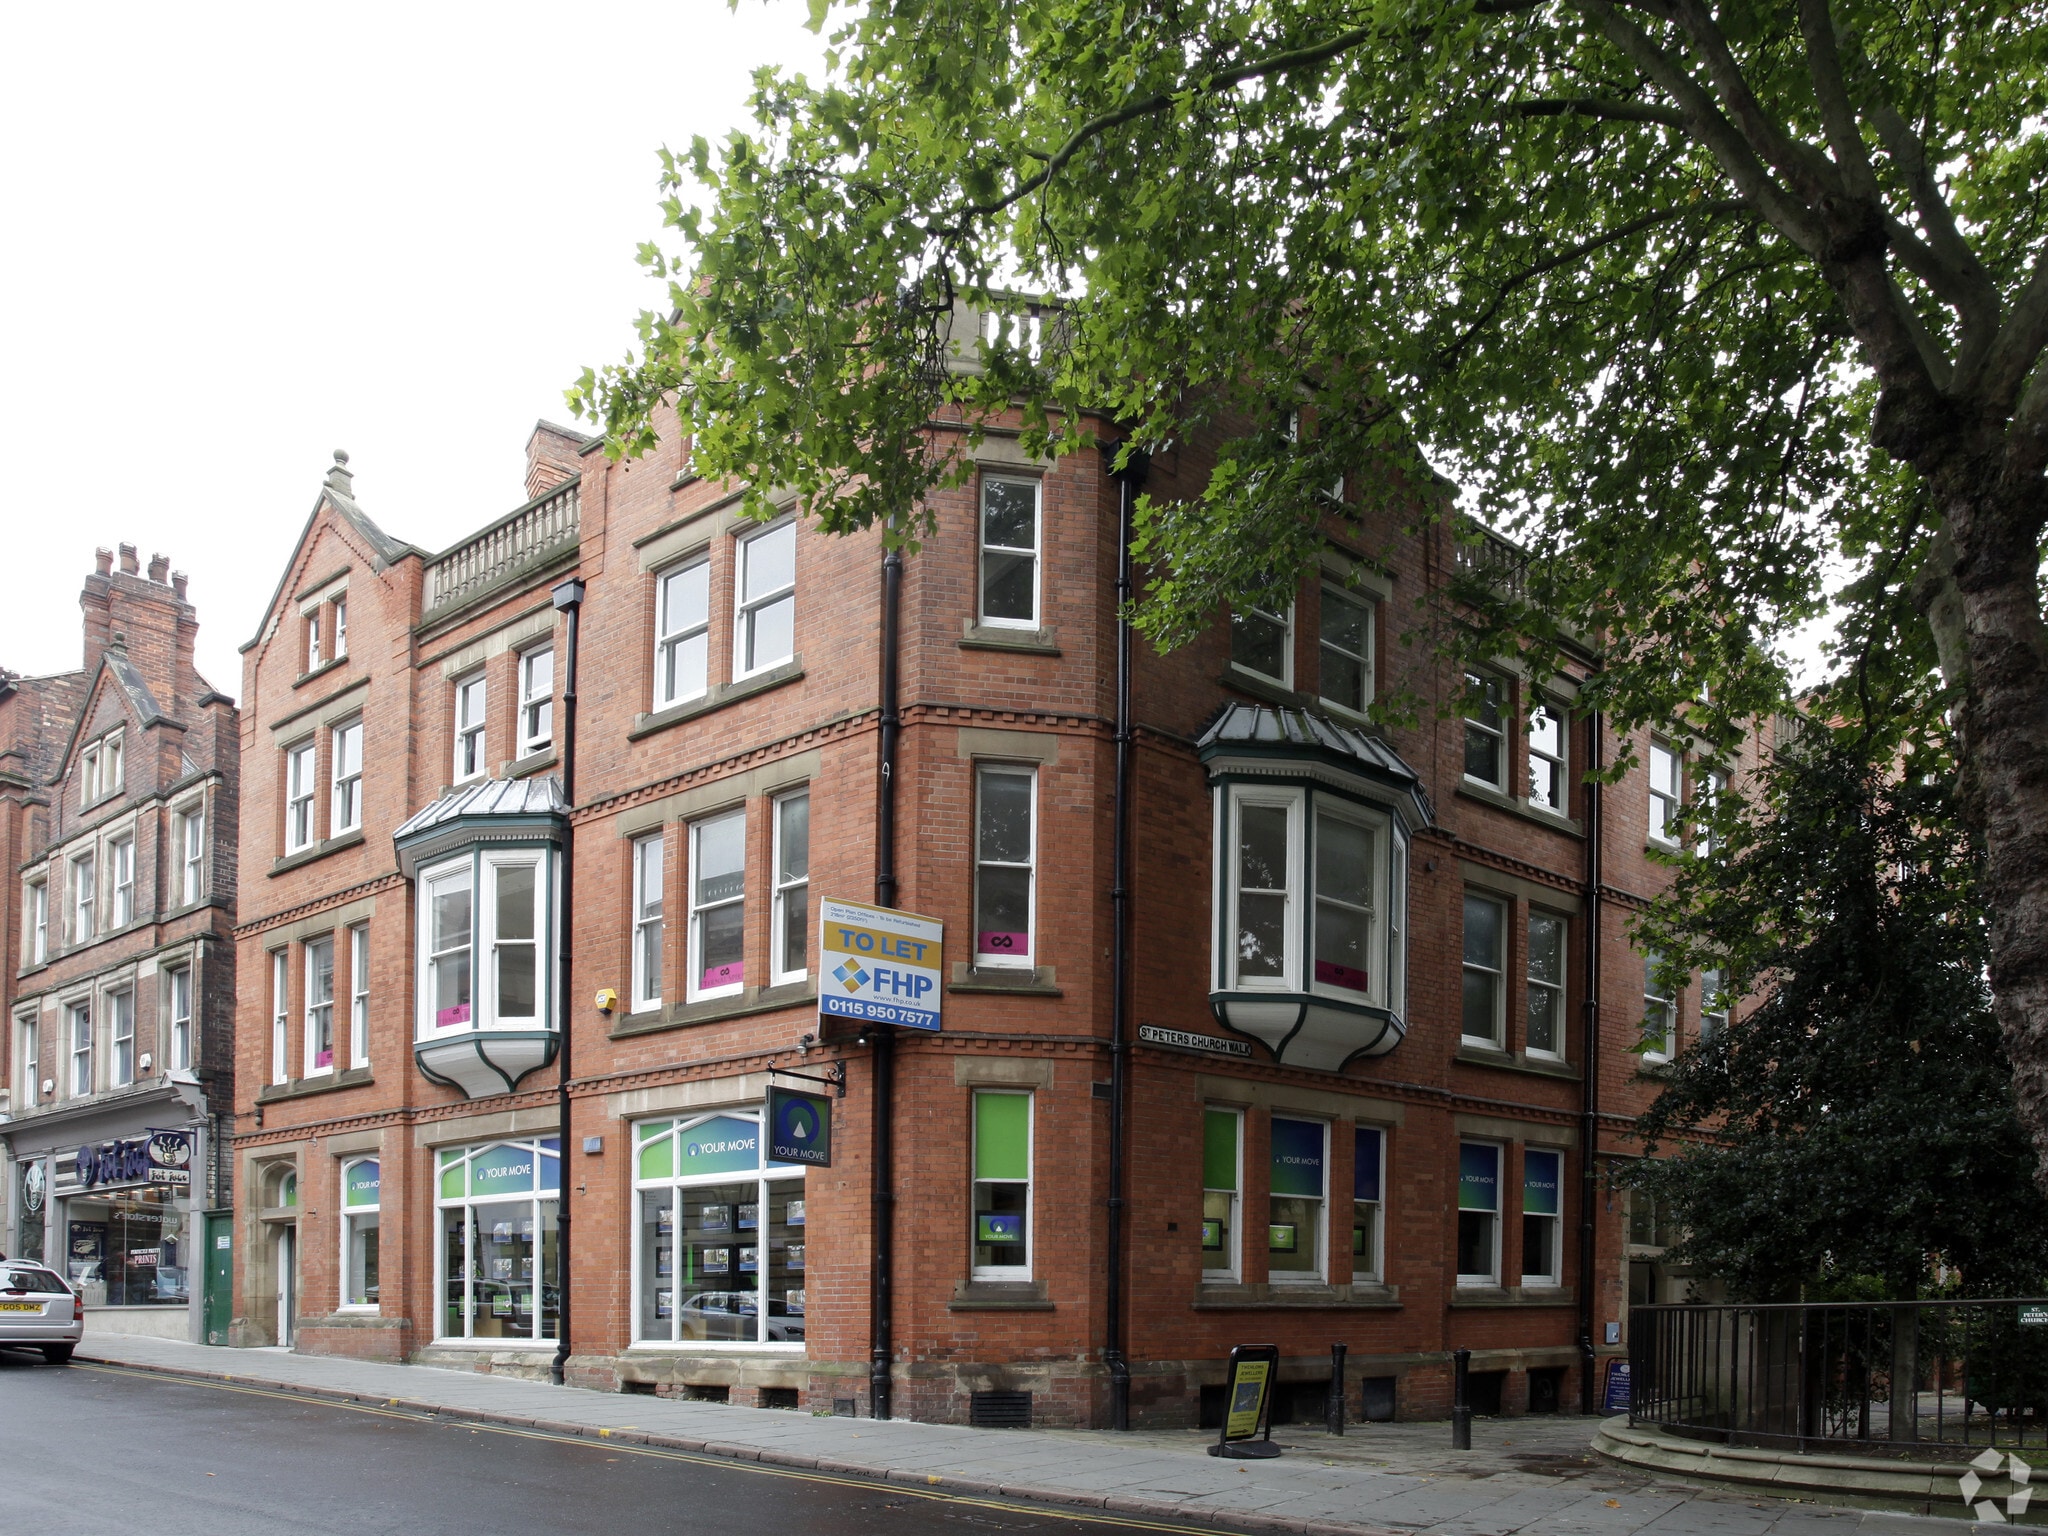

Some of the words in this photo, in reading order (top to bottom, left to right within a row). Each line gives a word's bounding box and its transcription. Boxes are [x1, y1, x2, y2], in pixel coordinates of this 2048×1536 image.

[838, 929, 875, 951] TO
[881, 937, 928, 960] LET
[873, 967, 933, 999] FHP
[873, 994, 921, 1007] www.fhp.co.uk
[828, 999, 863, 1014] 0115
[866, 1005, 896, 1020] 950
[898, 1010, 933, 1026] 7577
[1152, 1030, 1189, 1044] PETERS
[1191, 1036, 1227, 1051] CHURCH
[1228, 1042, 1251, 1053] WALK
[700, 1142, 726, 1154] YOUR
[727, 1138, 755, 1150] MOVE
[774, 1145, 798, 1157] YOUR
[800, 1149, 824, 1160] MOVE
[1282, 1156, 1300, 1165] YOUR
[1301, 1157, 1319, 1166] MOVE
[486, 1167, 507, 1178] YOUR
[508, 1164, 531, 1175] MOVE
[356, 1181, 370, 1189] YOUR
[1465, 1175, 1479, 1183] YOUR
[1480, 1176, 1494, 1184] MOVE
[134, 1254, 157, 1264] PRINTS
